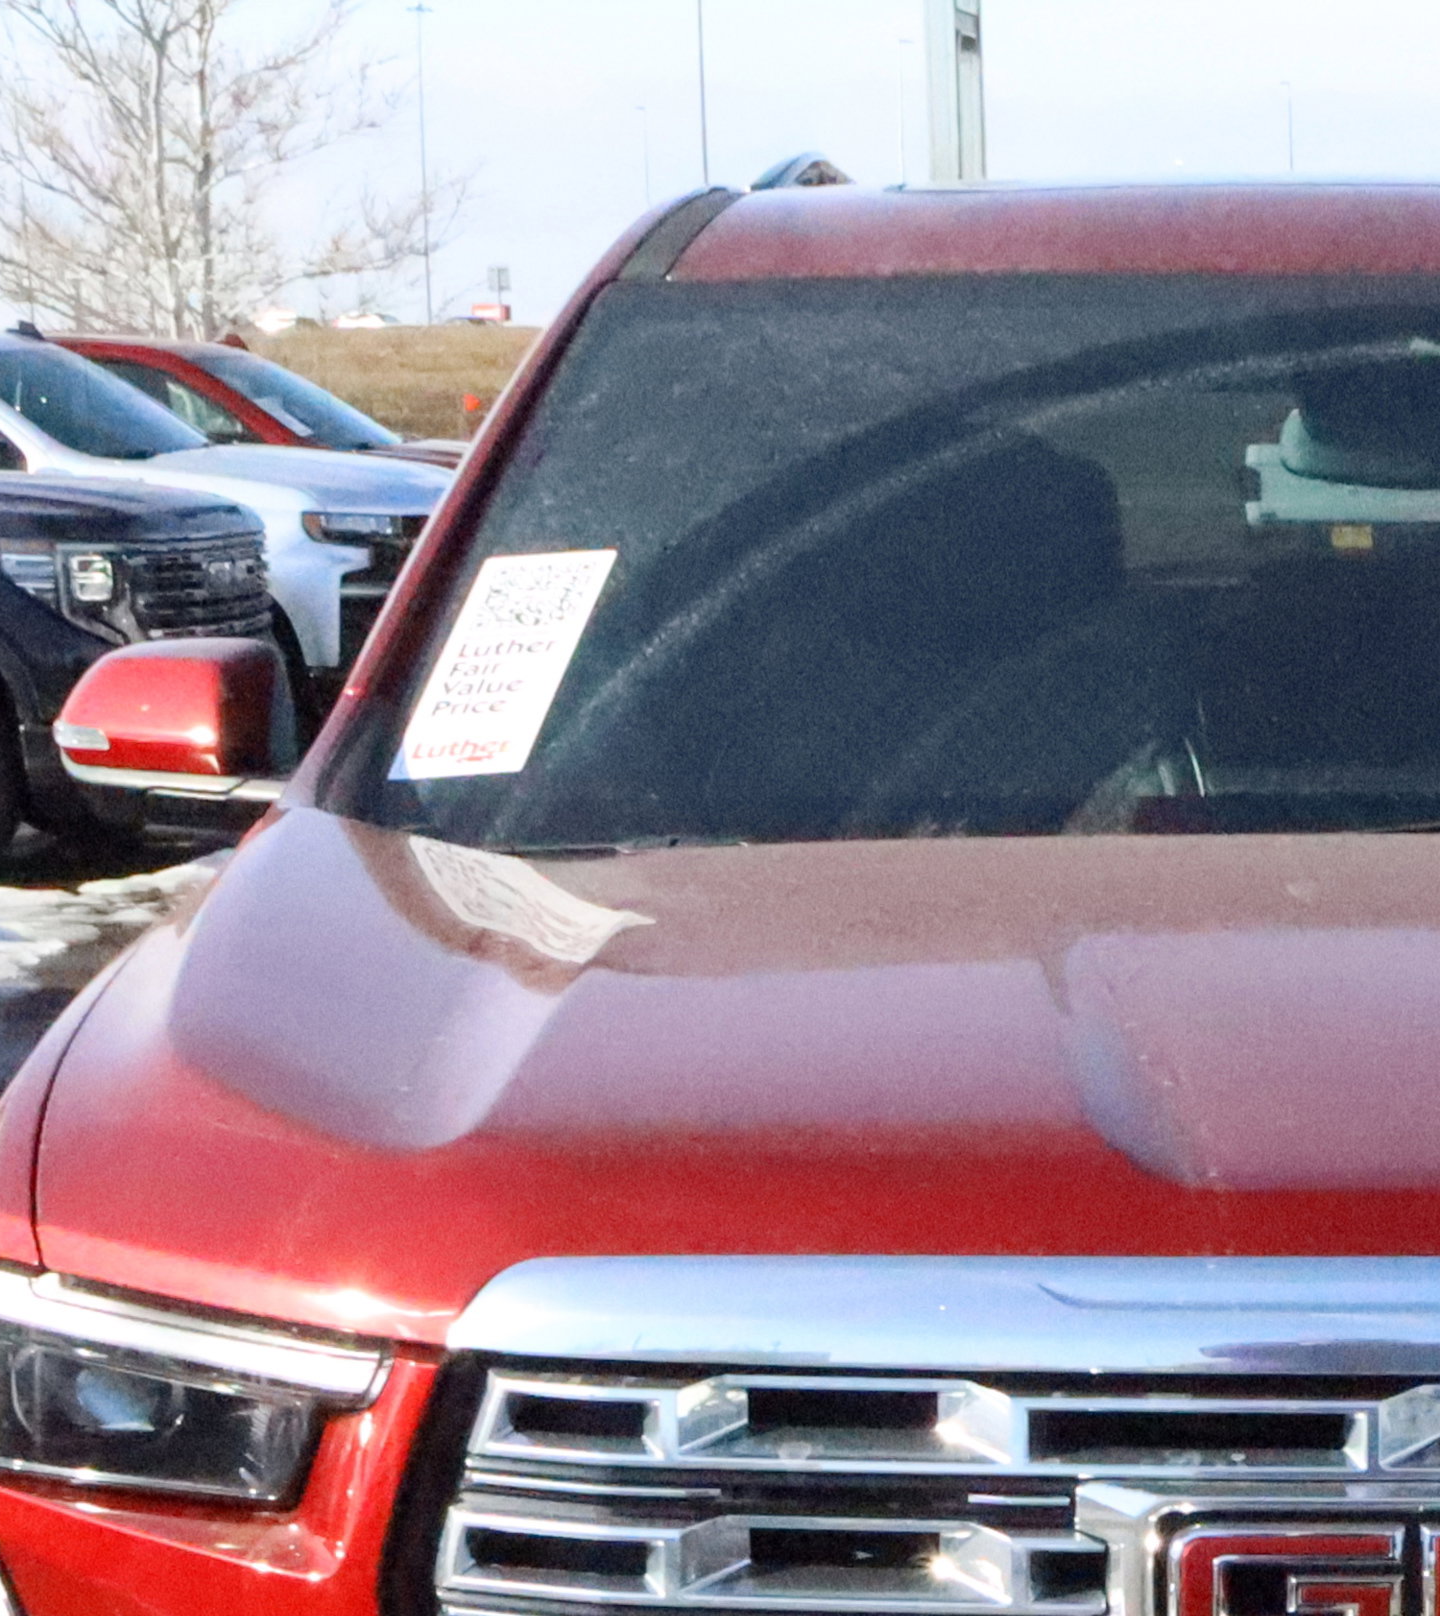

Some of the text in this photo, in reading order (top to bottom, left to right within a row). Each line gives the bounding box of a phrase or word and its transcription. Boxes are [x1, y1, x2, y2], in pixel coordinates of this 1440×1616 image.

[457, 639, 557, 659] Luther
[449, 661, 502, 678] Fair
[442, 679, 525, 696] Value
[431, 699, 507, 718] Price
[411, 738, 510, 760] Luther
